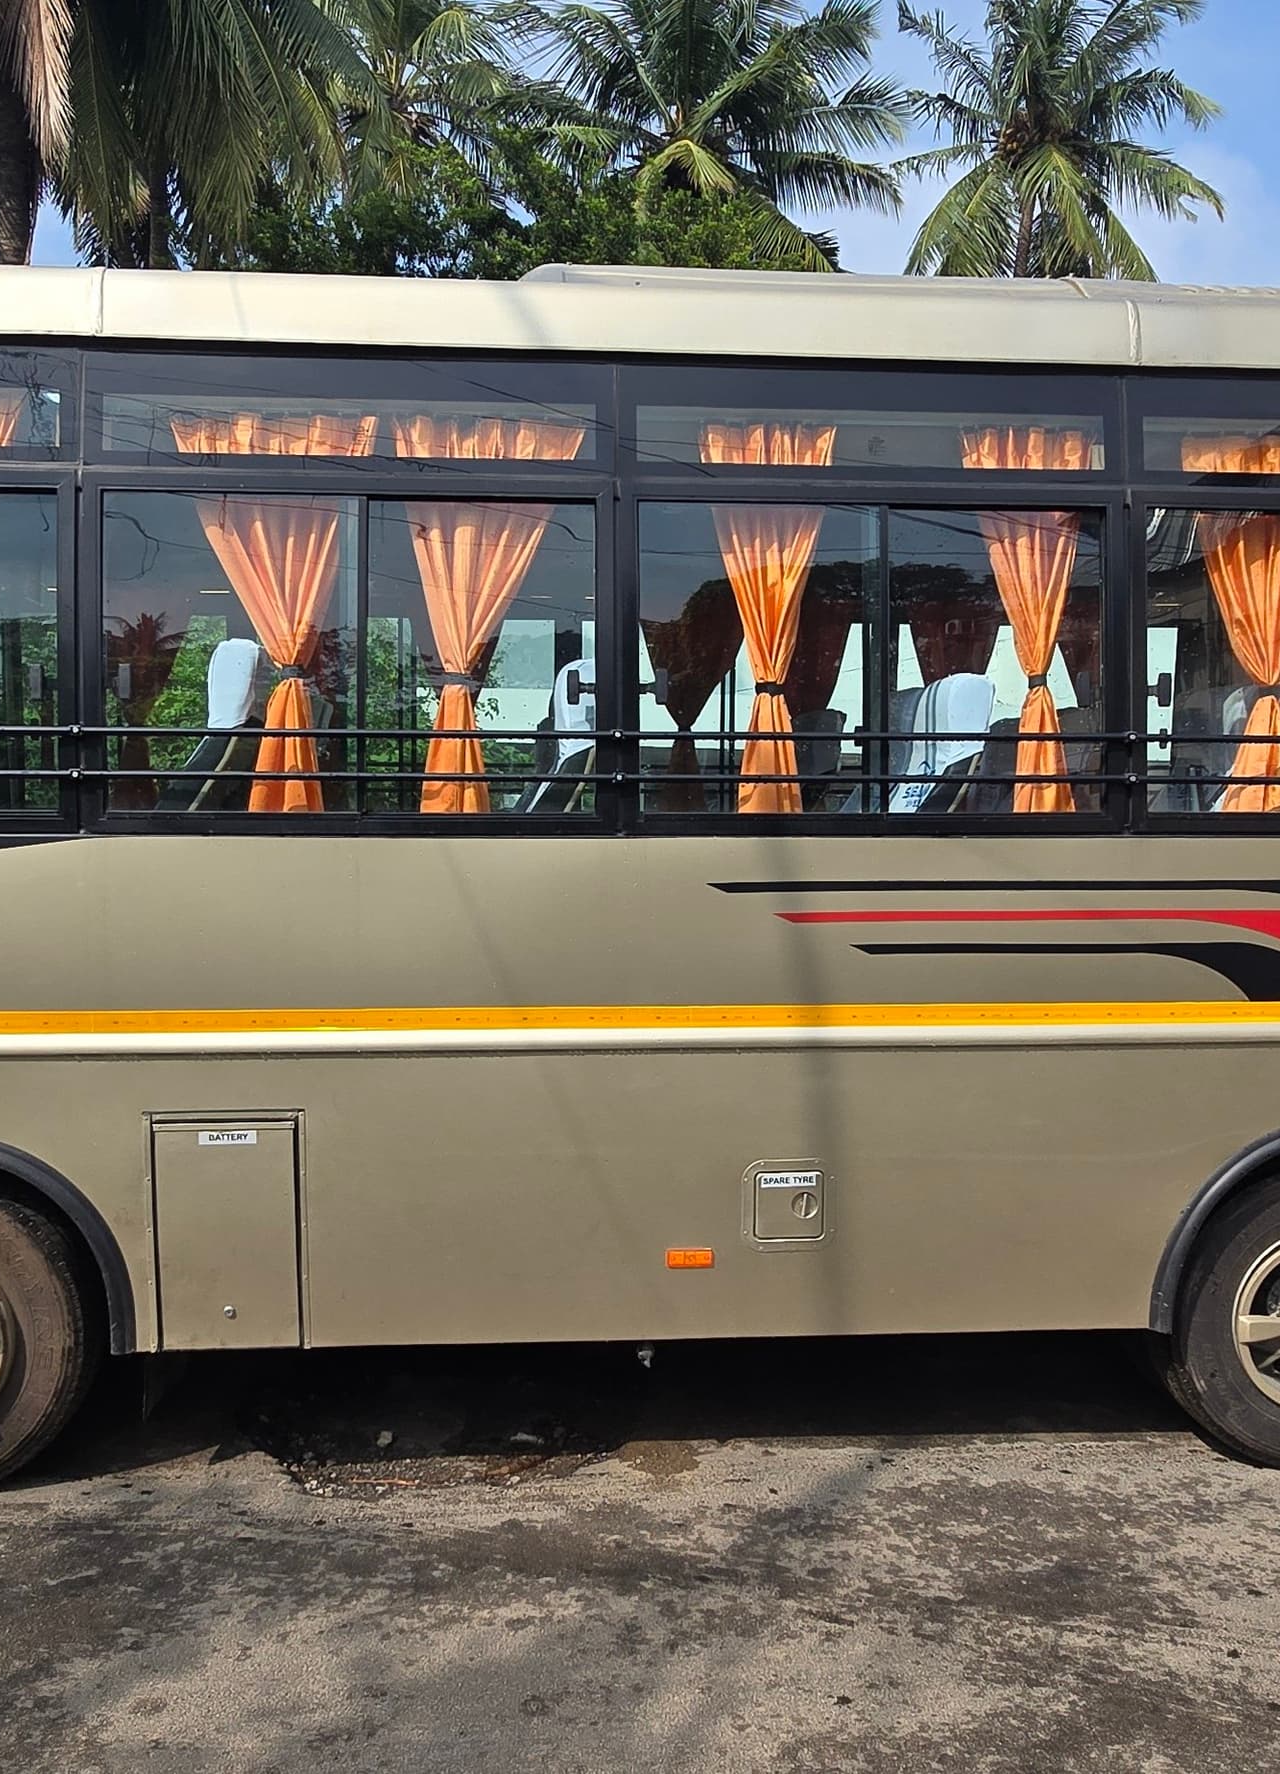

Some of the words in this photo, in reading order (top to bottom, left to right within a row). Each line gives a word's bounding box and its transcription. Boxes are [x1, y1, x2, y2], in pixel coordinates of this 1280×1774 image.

[208, 1133, 249, 1142] BATTERY
[762, 1176, 791, 1185] SPARE
[792, 1175, 815, 1184] TYRE
